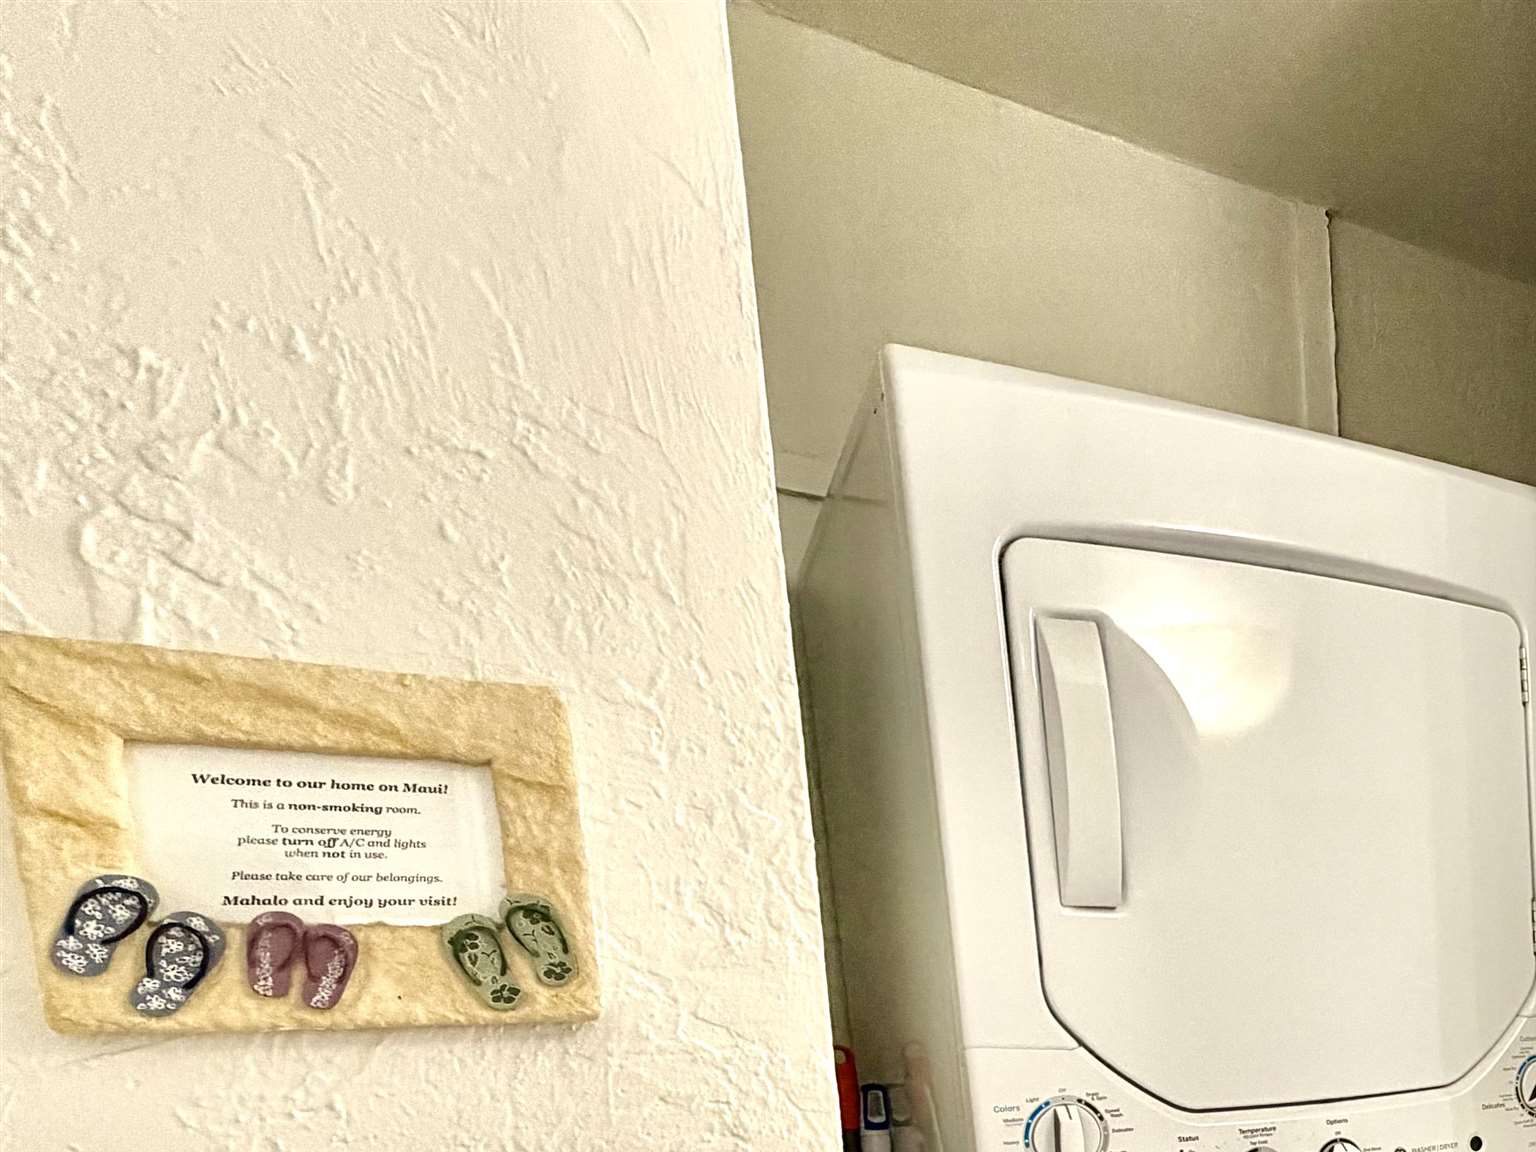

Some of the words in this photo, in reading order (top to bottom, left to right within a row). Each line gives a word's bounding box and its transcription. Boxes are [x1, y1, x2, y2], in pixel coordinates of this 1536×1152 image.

[192, 773, 272, 787] Welcome
[276, 778, 293, 788] to
[296, 780, 327, 789] our
[331, 779, 375, 791] home
[378, 783, 399, 792] on
[402, 783, 448, 794] Maui!
[231, 798, 260, 809] This
[263, 800, 274, 810] is
[276, 802, 286, 810] a
[288, 802, 383, 815] non-smoking
[386, 806, 422, 815] room.
[271, 824, 290, 834] To
[291, 826, 347, 835] conserve
[349, 828, 392, 839] energy
[237, 835, 279, 847] please
[282, 837, 315, 847] turn
[317, 837, 340, 849] off
[340, 838, 366, 849] A/C
[367, 839, 391, 848] and
[393, 839, 428, 851] lights
[284, 848, 319, 858] when
[322, 850, 346, 859] not
[349, 849, 362, 859] in
[231, 870, 273, 881] Please
[275, 871, 303, 881] take
[305, 873, 334, 881] care
[336, 871, 350, 884] of
[351, 874, 373, 882] our
[375, 872, 444, 885] belongings.
[221, 895, 290, 906] Mahalo
[292, 895, 325, 906] and
[328, 895, 374, 908] enjoy
[377, 898, 416, 908] your
[418, 896, 458, 906] visit!
[993, 1105, 1021, 1114] Colors
[1326, 1118, 1349, 1126] Options
[1237, 1125, 1277, 1135] Temperature
[1177, 1134, 1200, 1143] Status
